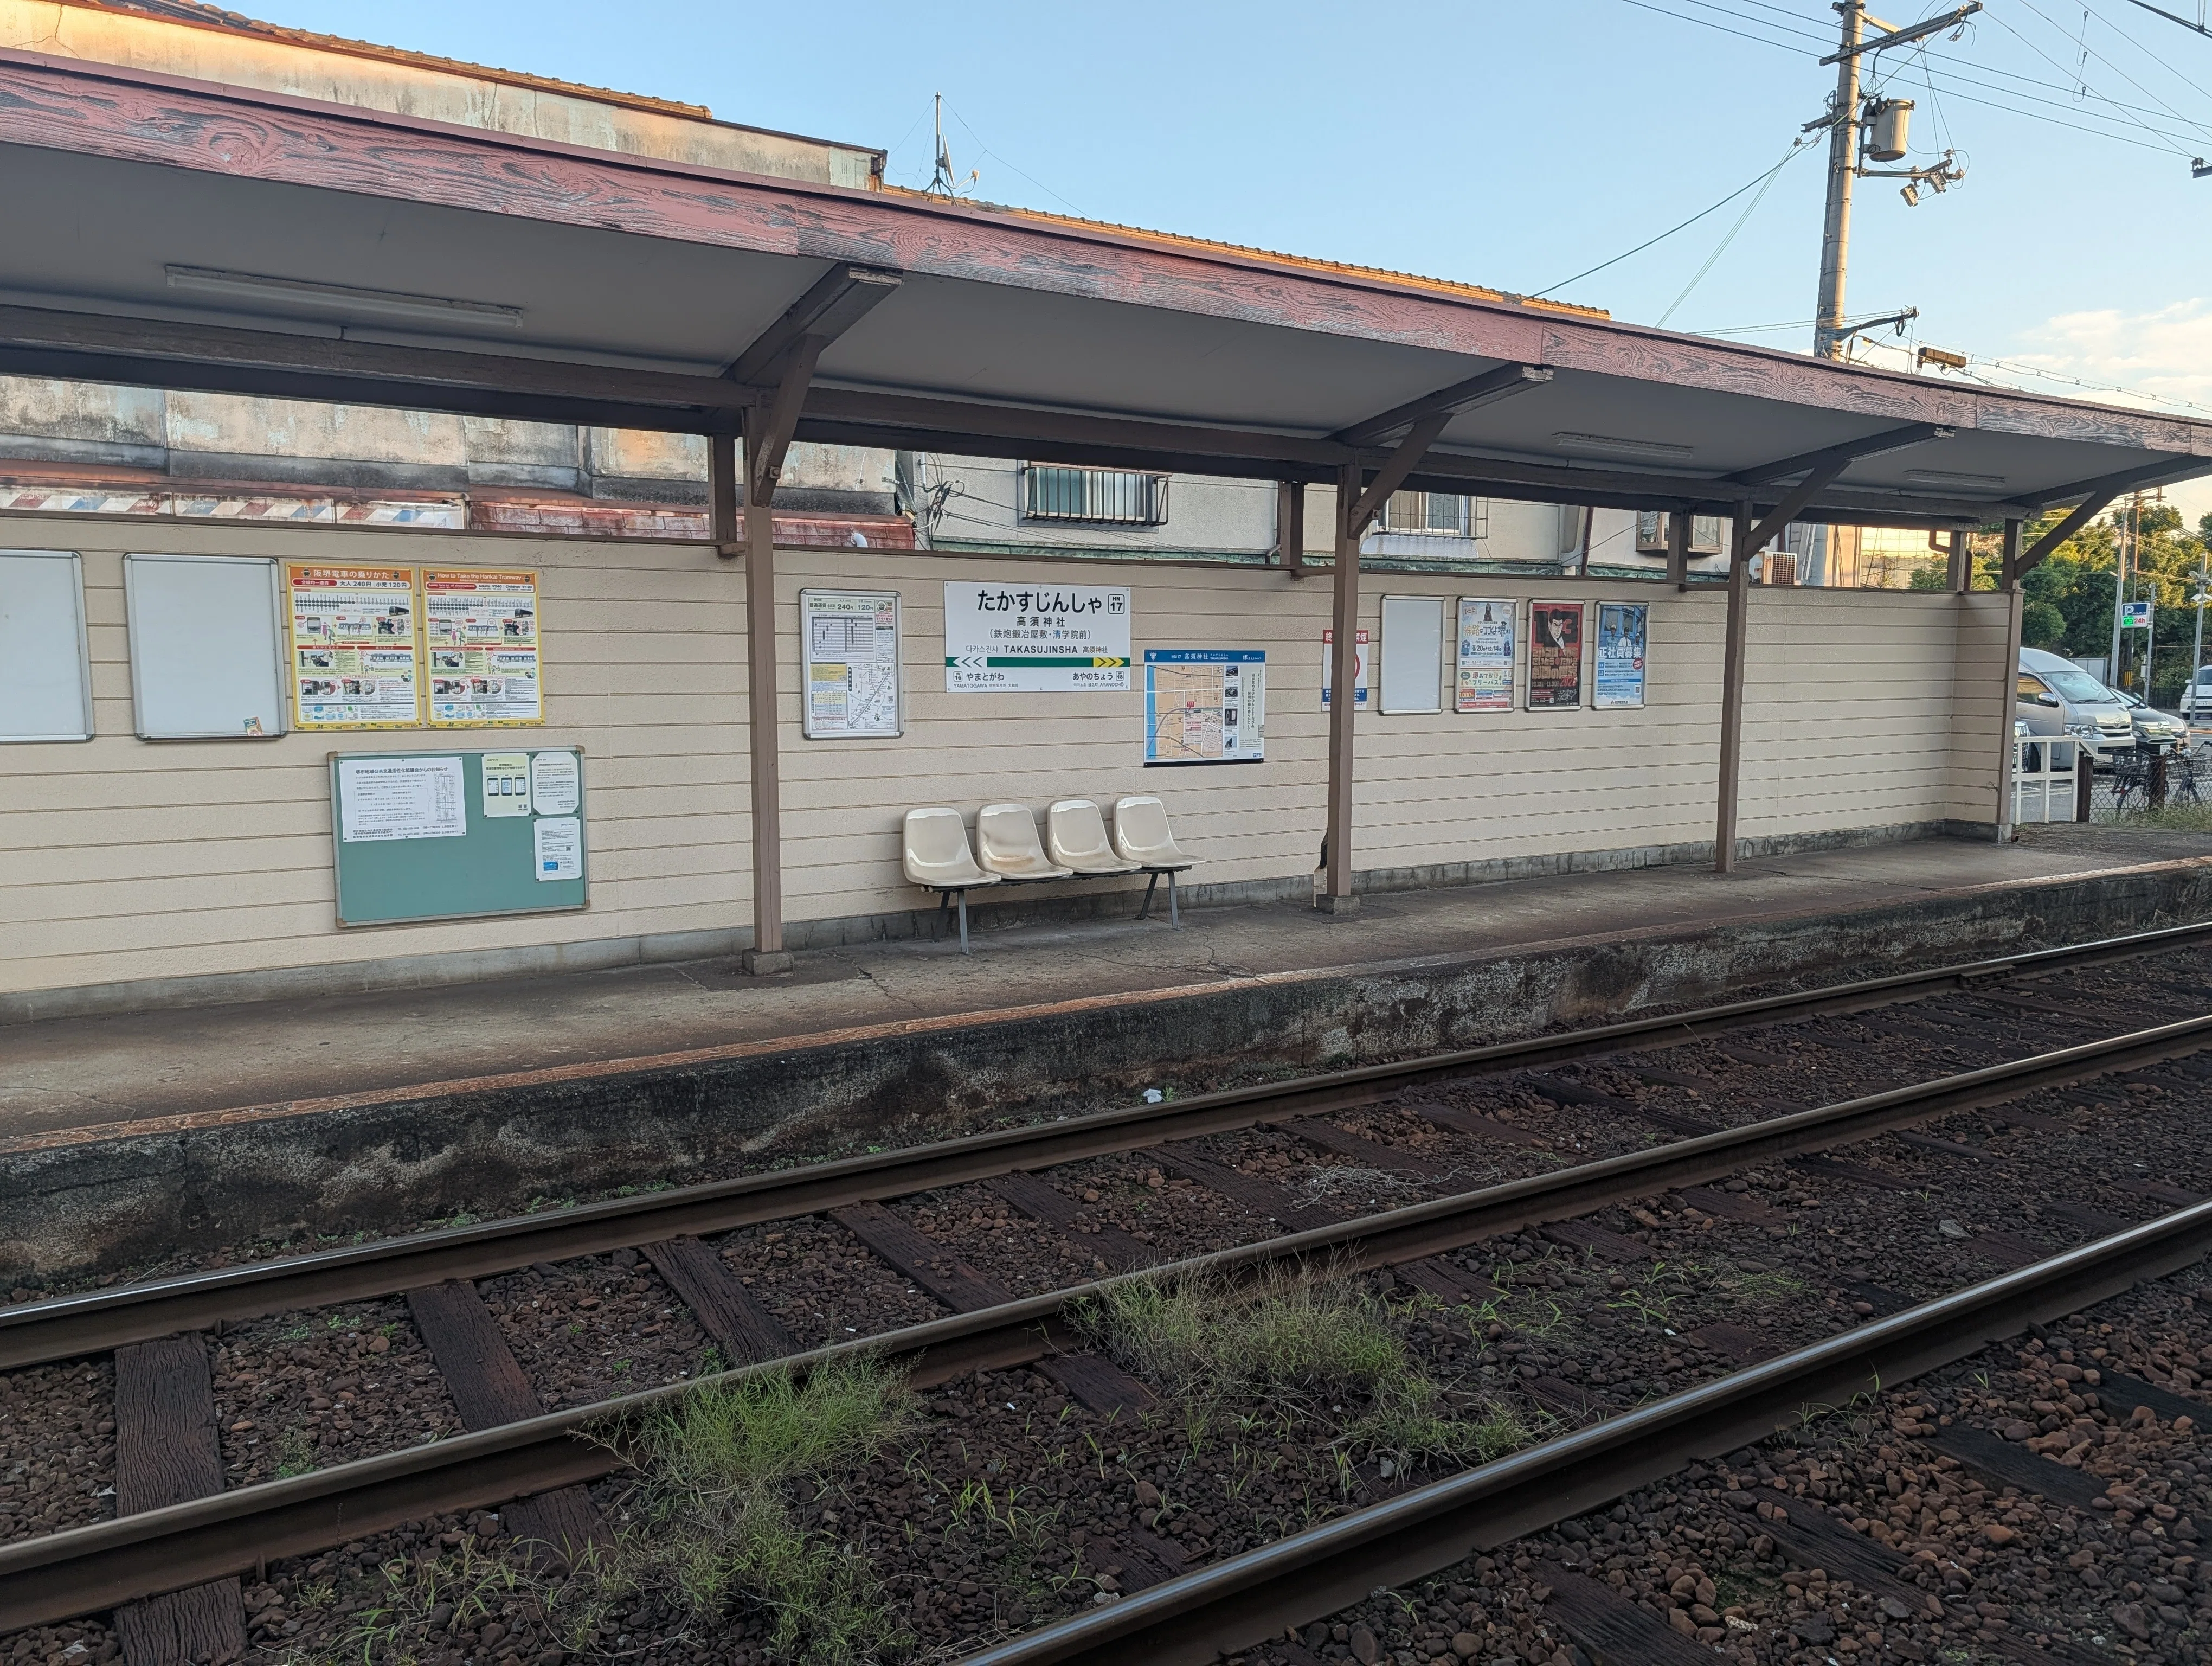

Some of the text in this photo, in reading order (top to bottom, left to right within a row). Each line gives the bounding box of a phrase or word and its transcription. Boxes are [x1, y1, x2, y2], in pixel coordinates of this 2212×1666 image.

[313, 569, 389, 579] 阪堺電車の乗りかた
[977, 589, 1102, 614] たかすじんしゃ
[1110, 601, 1123, 612] 17
[2125, 605, 2134, 616] P
[1017, 616, 1065, 627] 高須神社
[1004, 645, 1078, 653] TAKASUJINSHA
[1599, 646, 1641, 658] 正社員募集
[966, 672, 1005, 681] やまとがわ
[1072, 672, 1113, 681] あやのちょう
